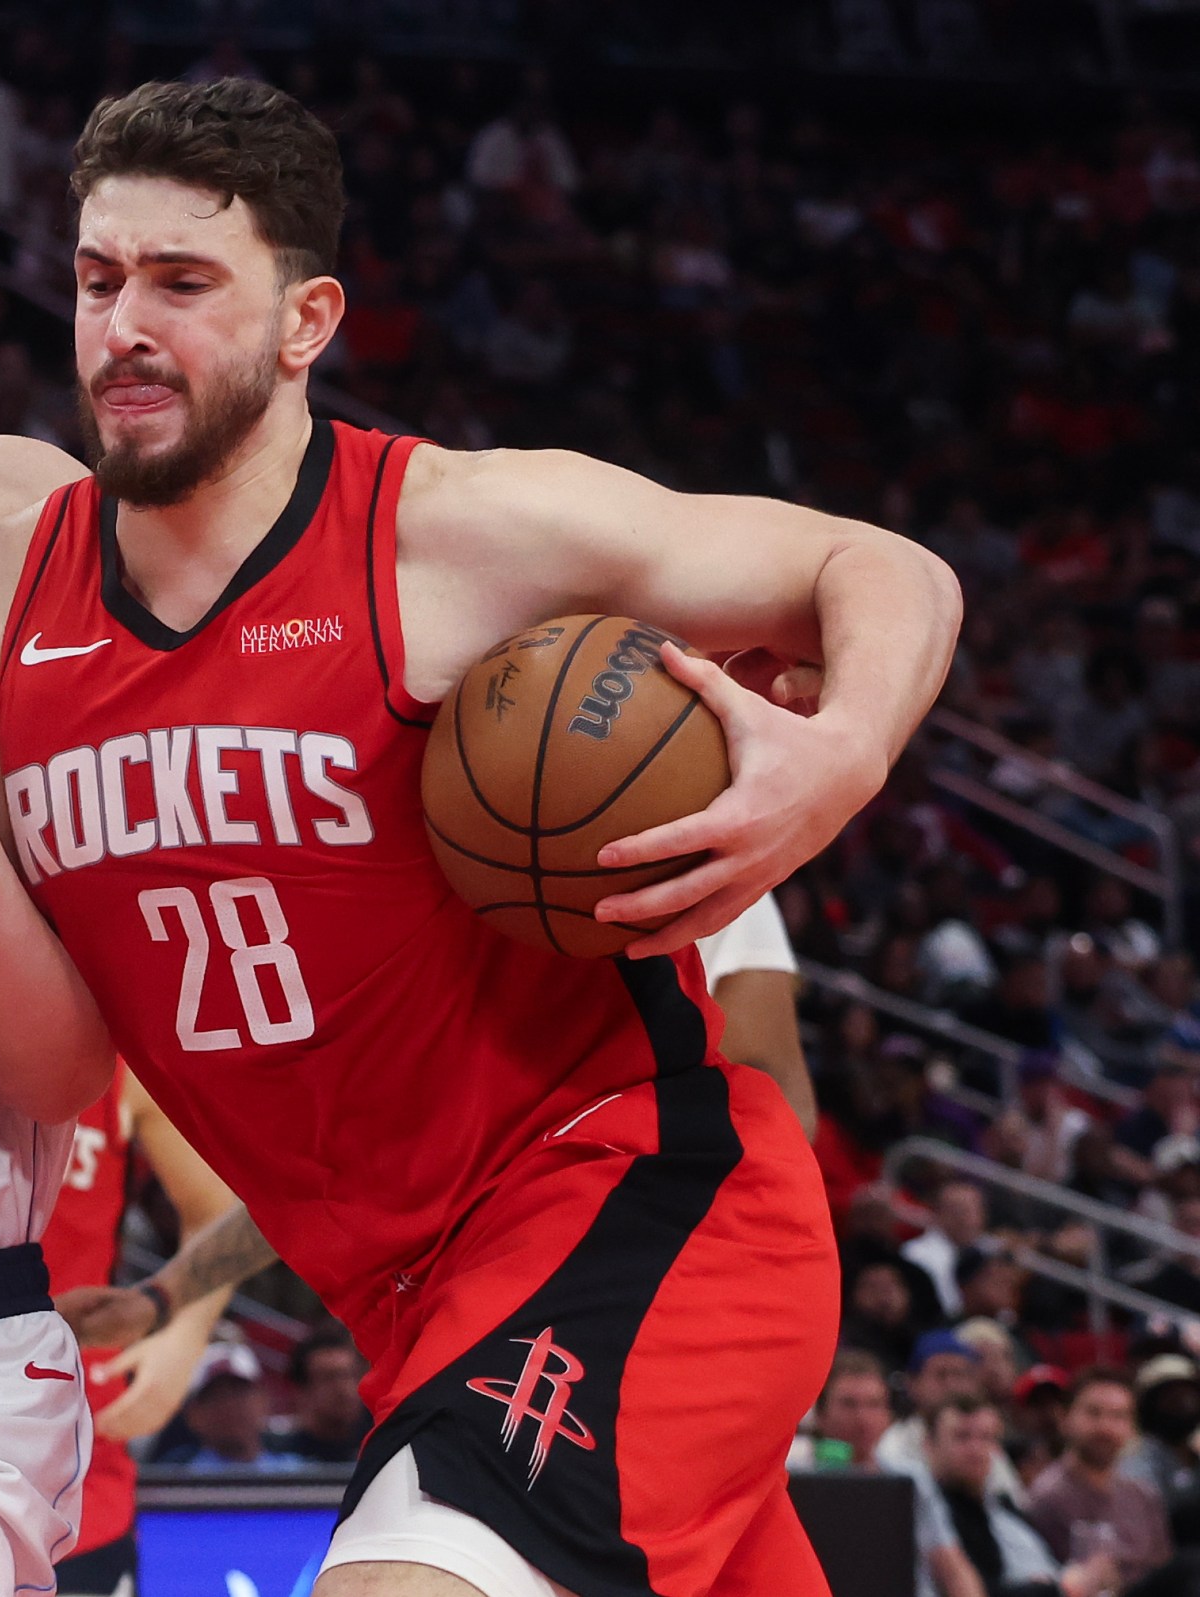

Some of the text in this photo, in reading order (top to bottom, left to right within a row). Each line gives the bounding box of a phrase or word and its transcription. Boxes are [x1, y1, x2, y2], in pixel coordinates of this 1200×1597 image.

[241, 615, 343, 641] MEMORIAL
[241, 628, 342, 654] HERMANN
[2, 725, 375, 886] ROCKETS
[138, 877, 315, 1051] 28
